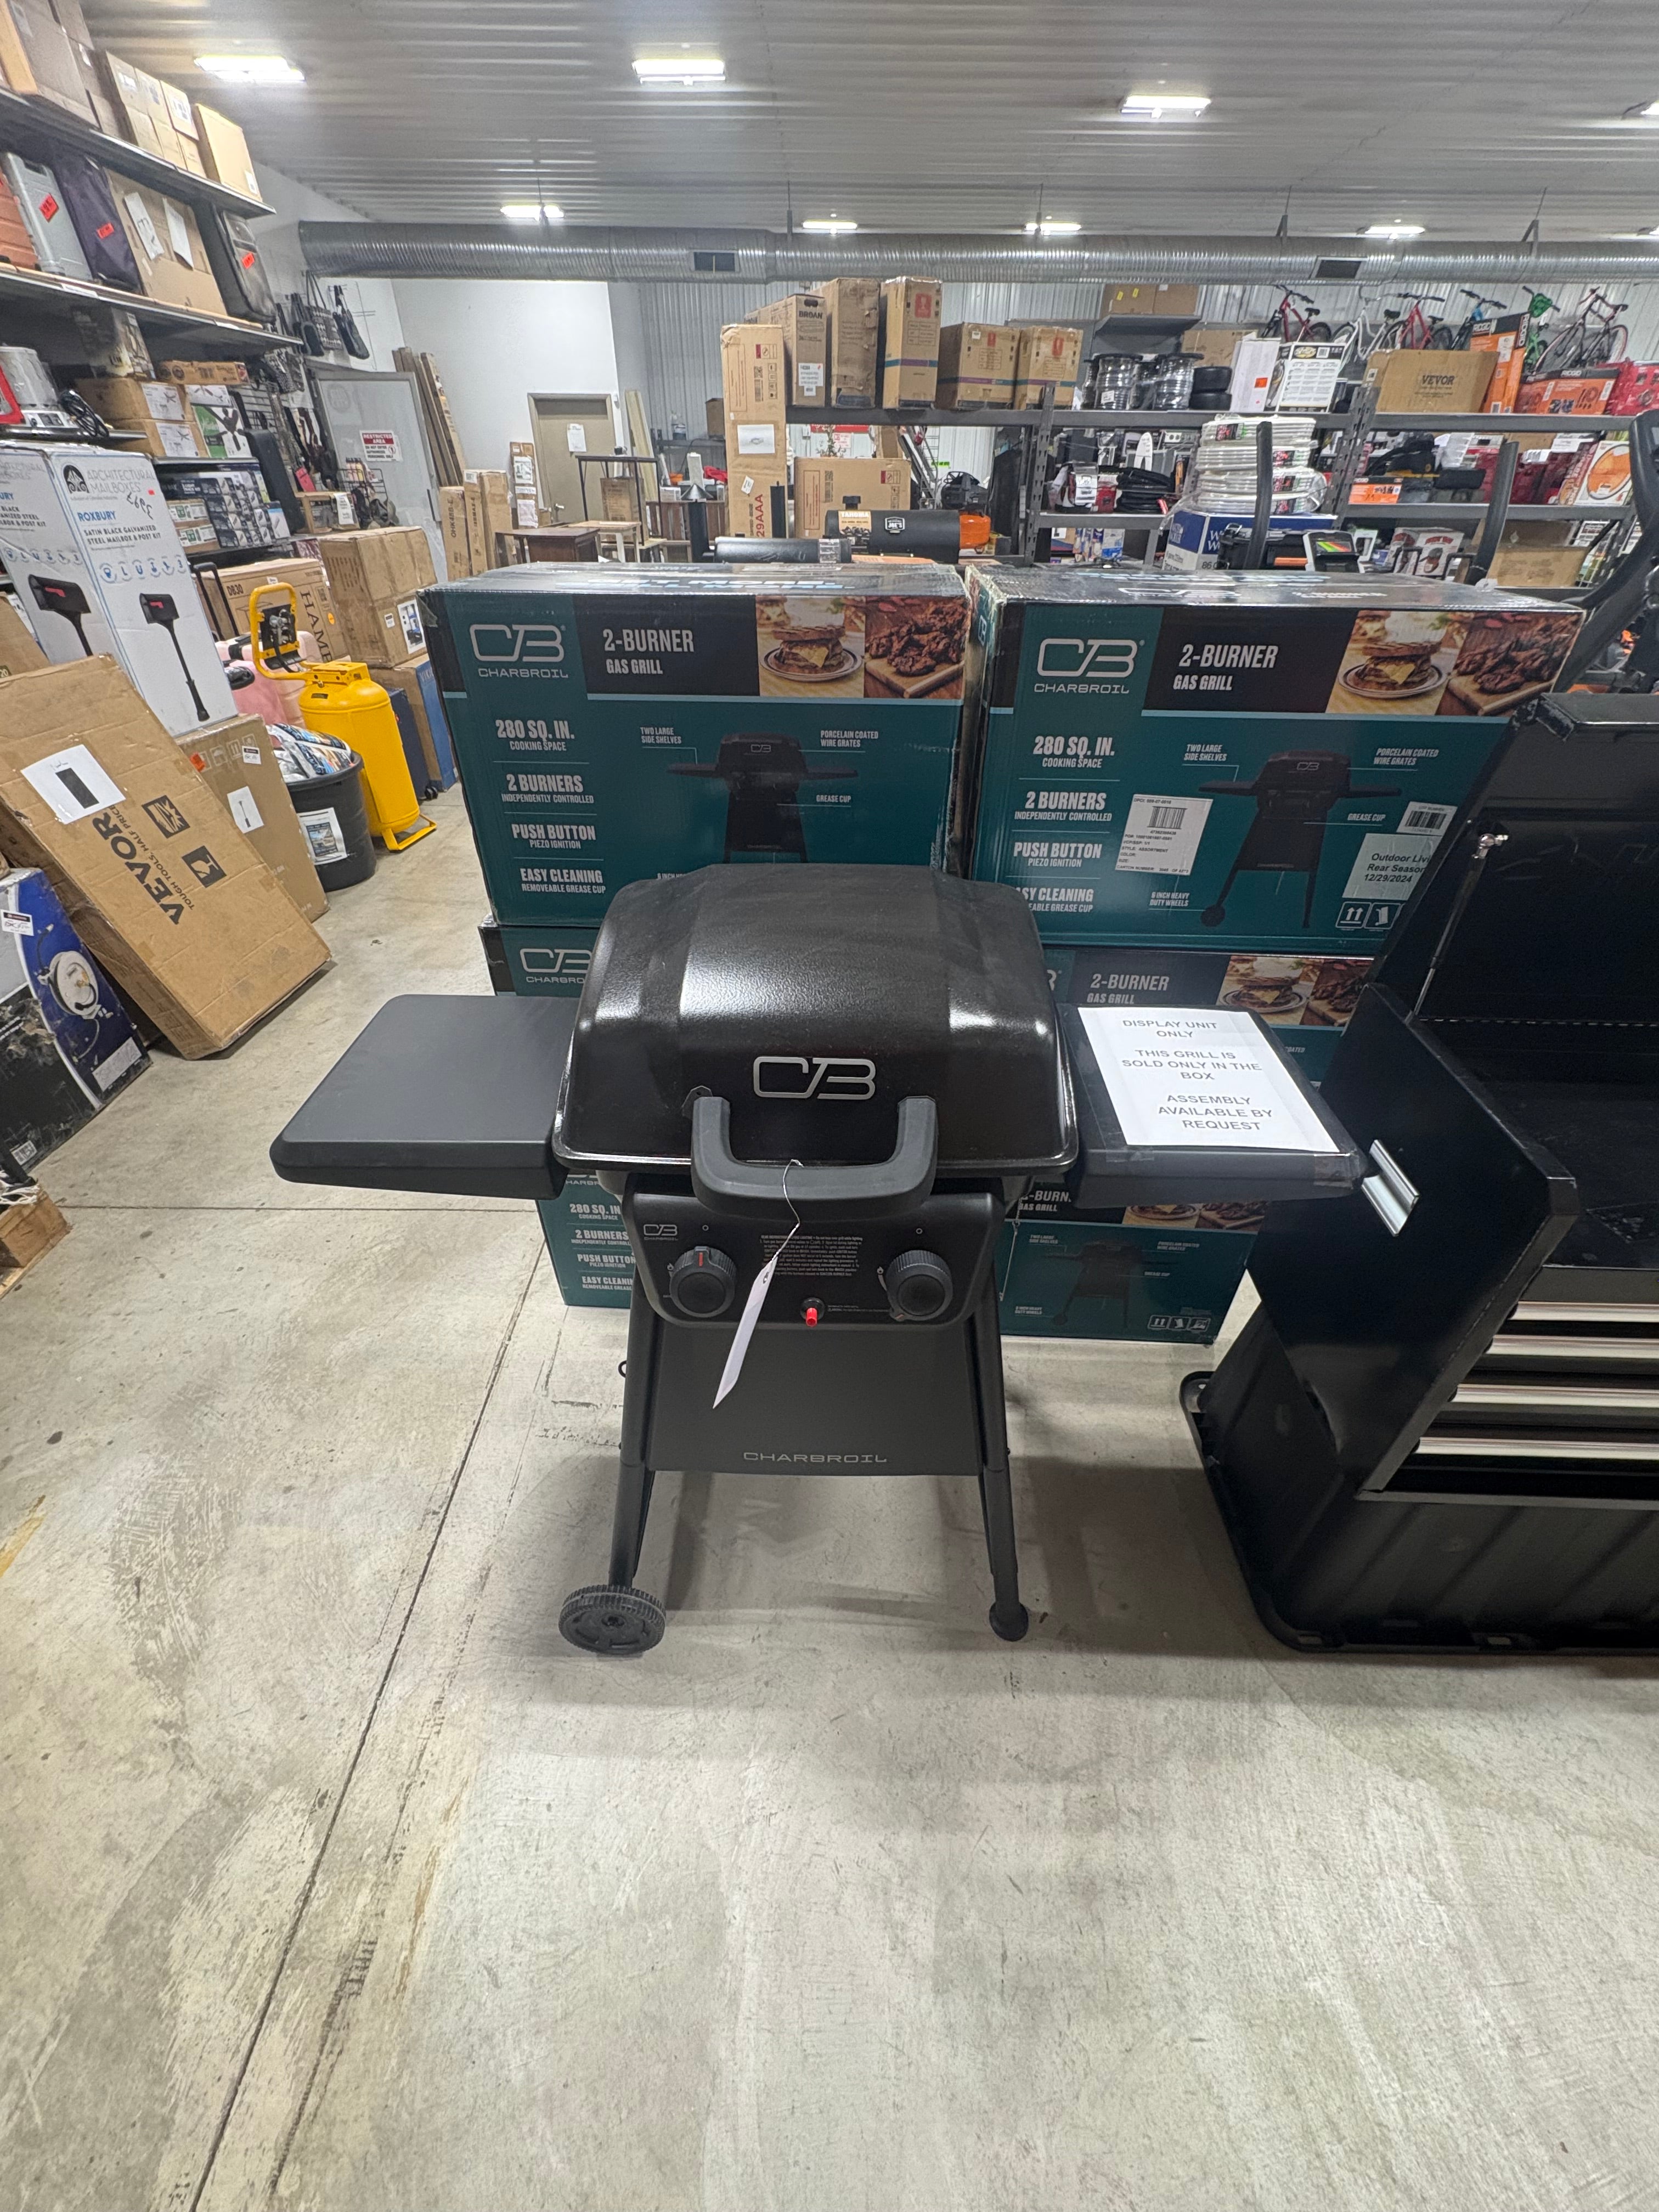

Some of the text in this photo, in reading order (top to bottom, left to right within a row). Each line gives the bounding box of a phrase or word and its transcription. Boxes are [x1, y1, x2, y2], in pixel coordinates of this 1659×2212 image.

[798, 311, 823, 319] BROAN
[1519, 313, 1531, 347] RIDGID
[1422, 375, 1455, 385] VEVOR
[86, 469, 155, 481] ARCHITECTURAL
[91, 482, 141, 493] MAILBOXES
[77, 510, 117, 522] ROXBURY
[104, 527, 122, 535] BLACK
[123, 524, 157, 533] GALVANIZED
[87, 537, 106, 545] STEEL
[107, 535, 133, 544] MAILBOX
[226, 584, 244, 596] DB30
[300, 590, 333, 662] HAMP
[603, 628, 695, 653] 2-BURNER
[1178, 644, 1279, 669] 2-BURNER
[606, 658, 663, 675] GAS GRILL
[478, 668, 569, 679] CHARBROIL
[1172, 674, 1233, 692] GAS GRILL
[1034, 683, 1130, 695] CHARBROIL
[495, 719, 575, 742] 280 SQ. IN.
[640, 726, 674, 736] TWO LARGE
[820, 730, 879, 740] PORCELAIN COATED
[641, 735, 682, 745] SIDE SHELVES
[820, 738, 861, 748] WIRE GRATES
[509, 741, 567, 751] COOKING SPACE
[1032, 735, 1115, 759] 280 SQ. IN.
[1186, 744, 1223, 753] TWO LARGE
[1183, 752, 1227, 762] SIDE SHELVES
[1376, 747, 1440, 758] PORCELAIN COATED
[1042, 757, 1103, 769] COOKING SPACE
[1373, 755, 1418, 766] WIRE GRATES
[506, 774, 584, 793] 2 BURNERS
[501, 793, 594, 804] INDEPENDENTLY CONTROLLED
[816, 794, 852, 804] GREASE CUP
[1024, 791, 1107, 810] 2 BURNERS
[1014, 811, 1113, 822] INDEPENDENTLY CONTROLLED
[1347, 812, 1386, 822] GREASE CUP
[511, 823, 597, 840] PUSH BUTTON
[529, 839, 582, 850] PIEZO IGNITION
[1013, 842, 1103, 859] PUSH BUTTON
[109, 804, 195, 911] TOUGH TOOLS, HALF PRICE
[1028, 857, 1082, 868] PIEZO IGNITION
[1372, 853, 1431, 864] Outdoor Livi
[92, 812, 184, 925] VEVOR
[1367, 864, 1389, 872] Rear
[520, 867, 603, 884] EASY CLEANING
[1364, 873, 1413, 883] 12/29/2024
[521, 883, 606, 894] REMOVEABLE GREASE CUP
[1037, 887, 1094, 903] CLEANING
[1171, 892, 1190, 900] HEAVY
[1050, 904, 1093, 913] GREASE CUP
[1166, 899, 1189, 907] WHEELS
[1090, 973, 1170, 992] 2-BURNER
[1086, 992, 1135, 1005] GAS GRILL
[1122, 1020, 1181, 1028] DISPLAY
[1134, 1049, 1170, 1058] THIS
[1173, 1051, 1219, 1059] GRILL
[1122, 1059, 1163, 1068] SOLD
[1167, 1060, 1206, 1070] ONLY
[1212, 1062, 1227, 1070] IN
[1180, 1071, 1215, 1080] BOX
[1167, 1095, 1251, 1105] ASSEMBLY
[1158, 1106, 1272, 1118] AVAILABLE BY
[1181, 1120, 1260, 1130] REQUEST
[569, 1203, 622, 1216] 280 SQ. IN
[1035, 1203, 1058, 1212] GRILL
[575, 1229, 630, 1240] 2 BURNERS
[577, 1254, 636, 1264] PUSH BUTTON
[582, 1276, 602, 1284] EASY
[743, 1452, 888, 1464] CHARBROIL
